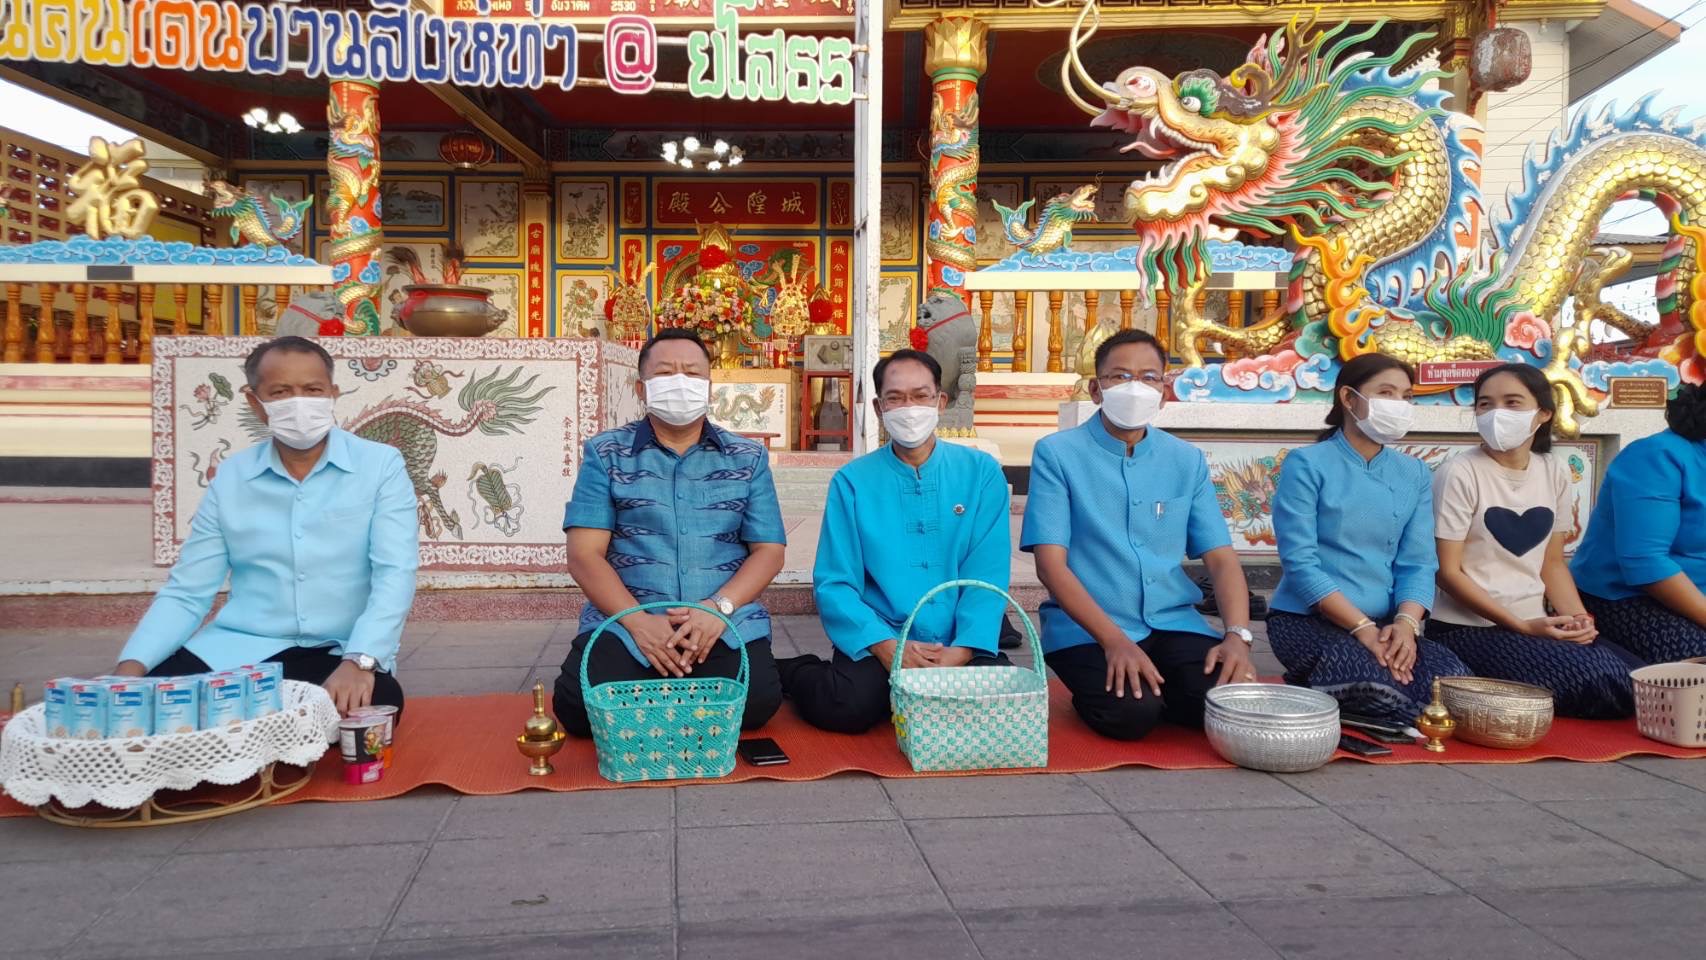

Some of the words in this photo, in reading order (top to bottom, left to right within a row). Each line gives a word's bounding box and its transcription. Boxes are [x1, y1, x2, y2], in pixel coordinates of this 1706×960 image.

[610, 0, 636, 12] 2530
[604, 15, 657, 94] @
[687, 0, 854, 105] ยโสธร
